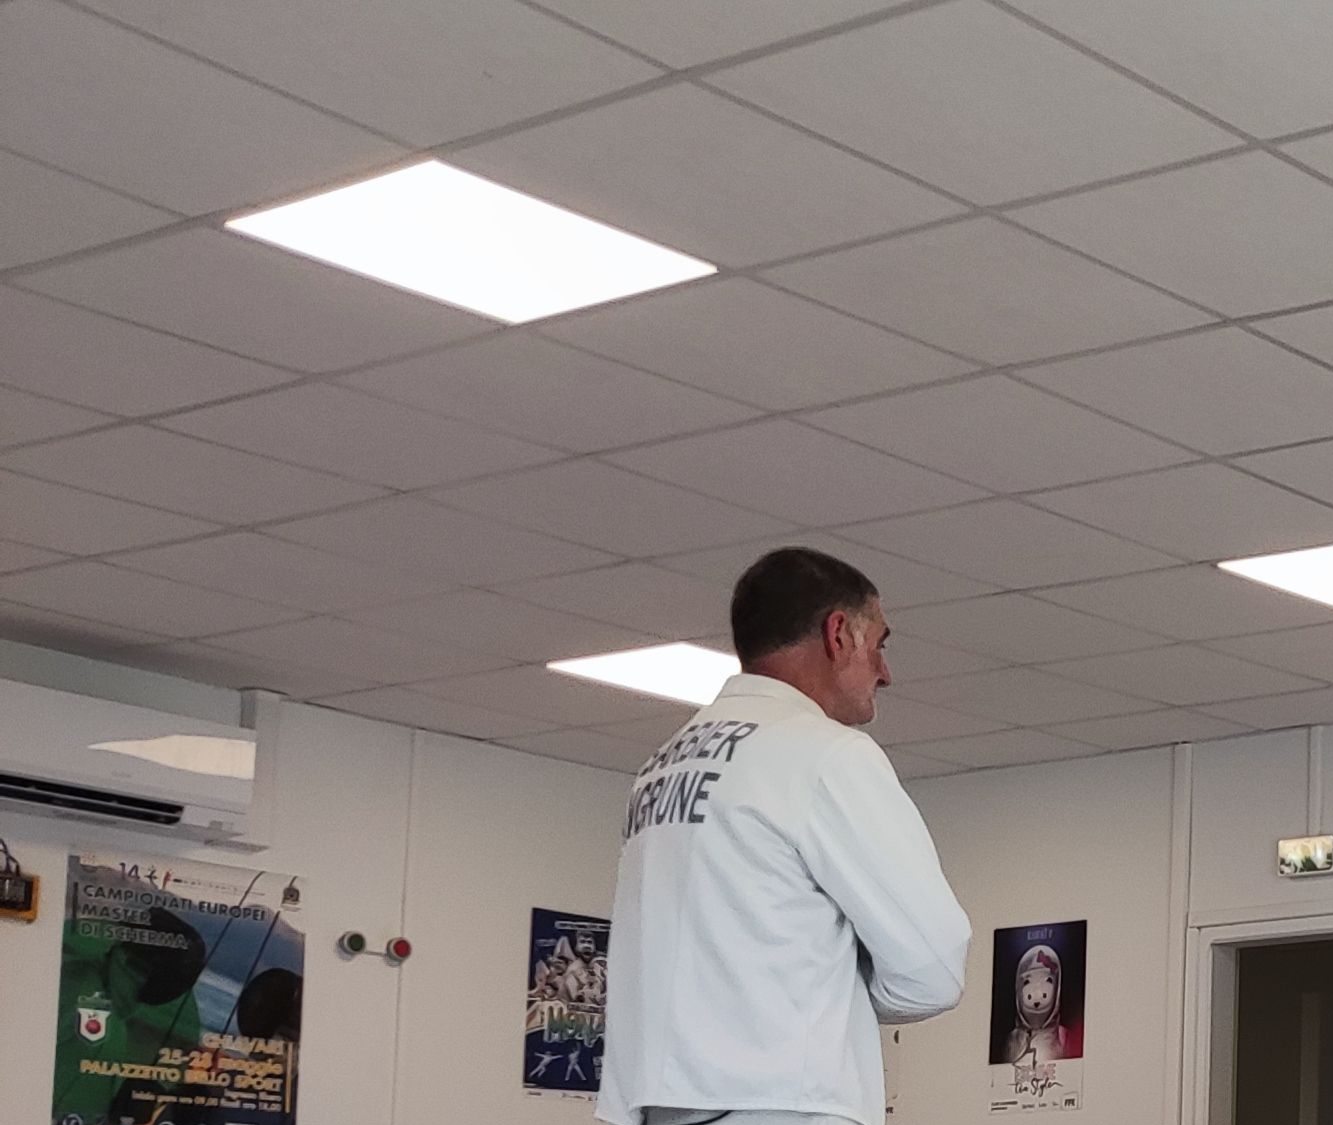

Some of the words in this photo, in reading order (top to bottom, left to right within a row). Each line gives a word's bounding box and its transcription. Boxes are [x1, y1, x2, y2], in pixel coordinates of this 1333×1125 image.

[82, 903, 152, 923] MASTER
[83, 884, 192, 911] CAMPIONATI
[199, 901, 266, 922] EUROPEI
[80, 922, 99, 936] DI
[106, 923, 189, 949] SCHERMA
[80, 1060, 181, 1083] PALAZZETTO
[234, 1074, 284, 1092] SPORT
